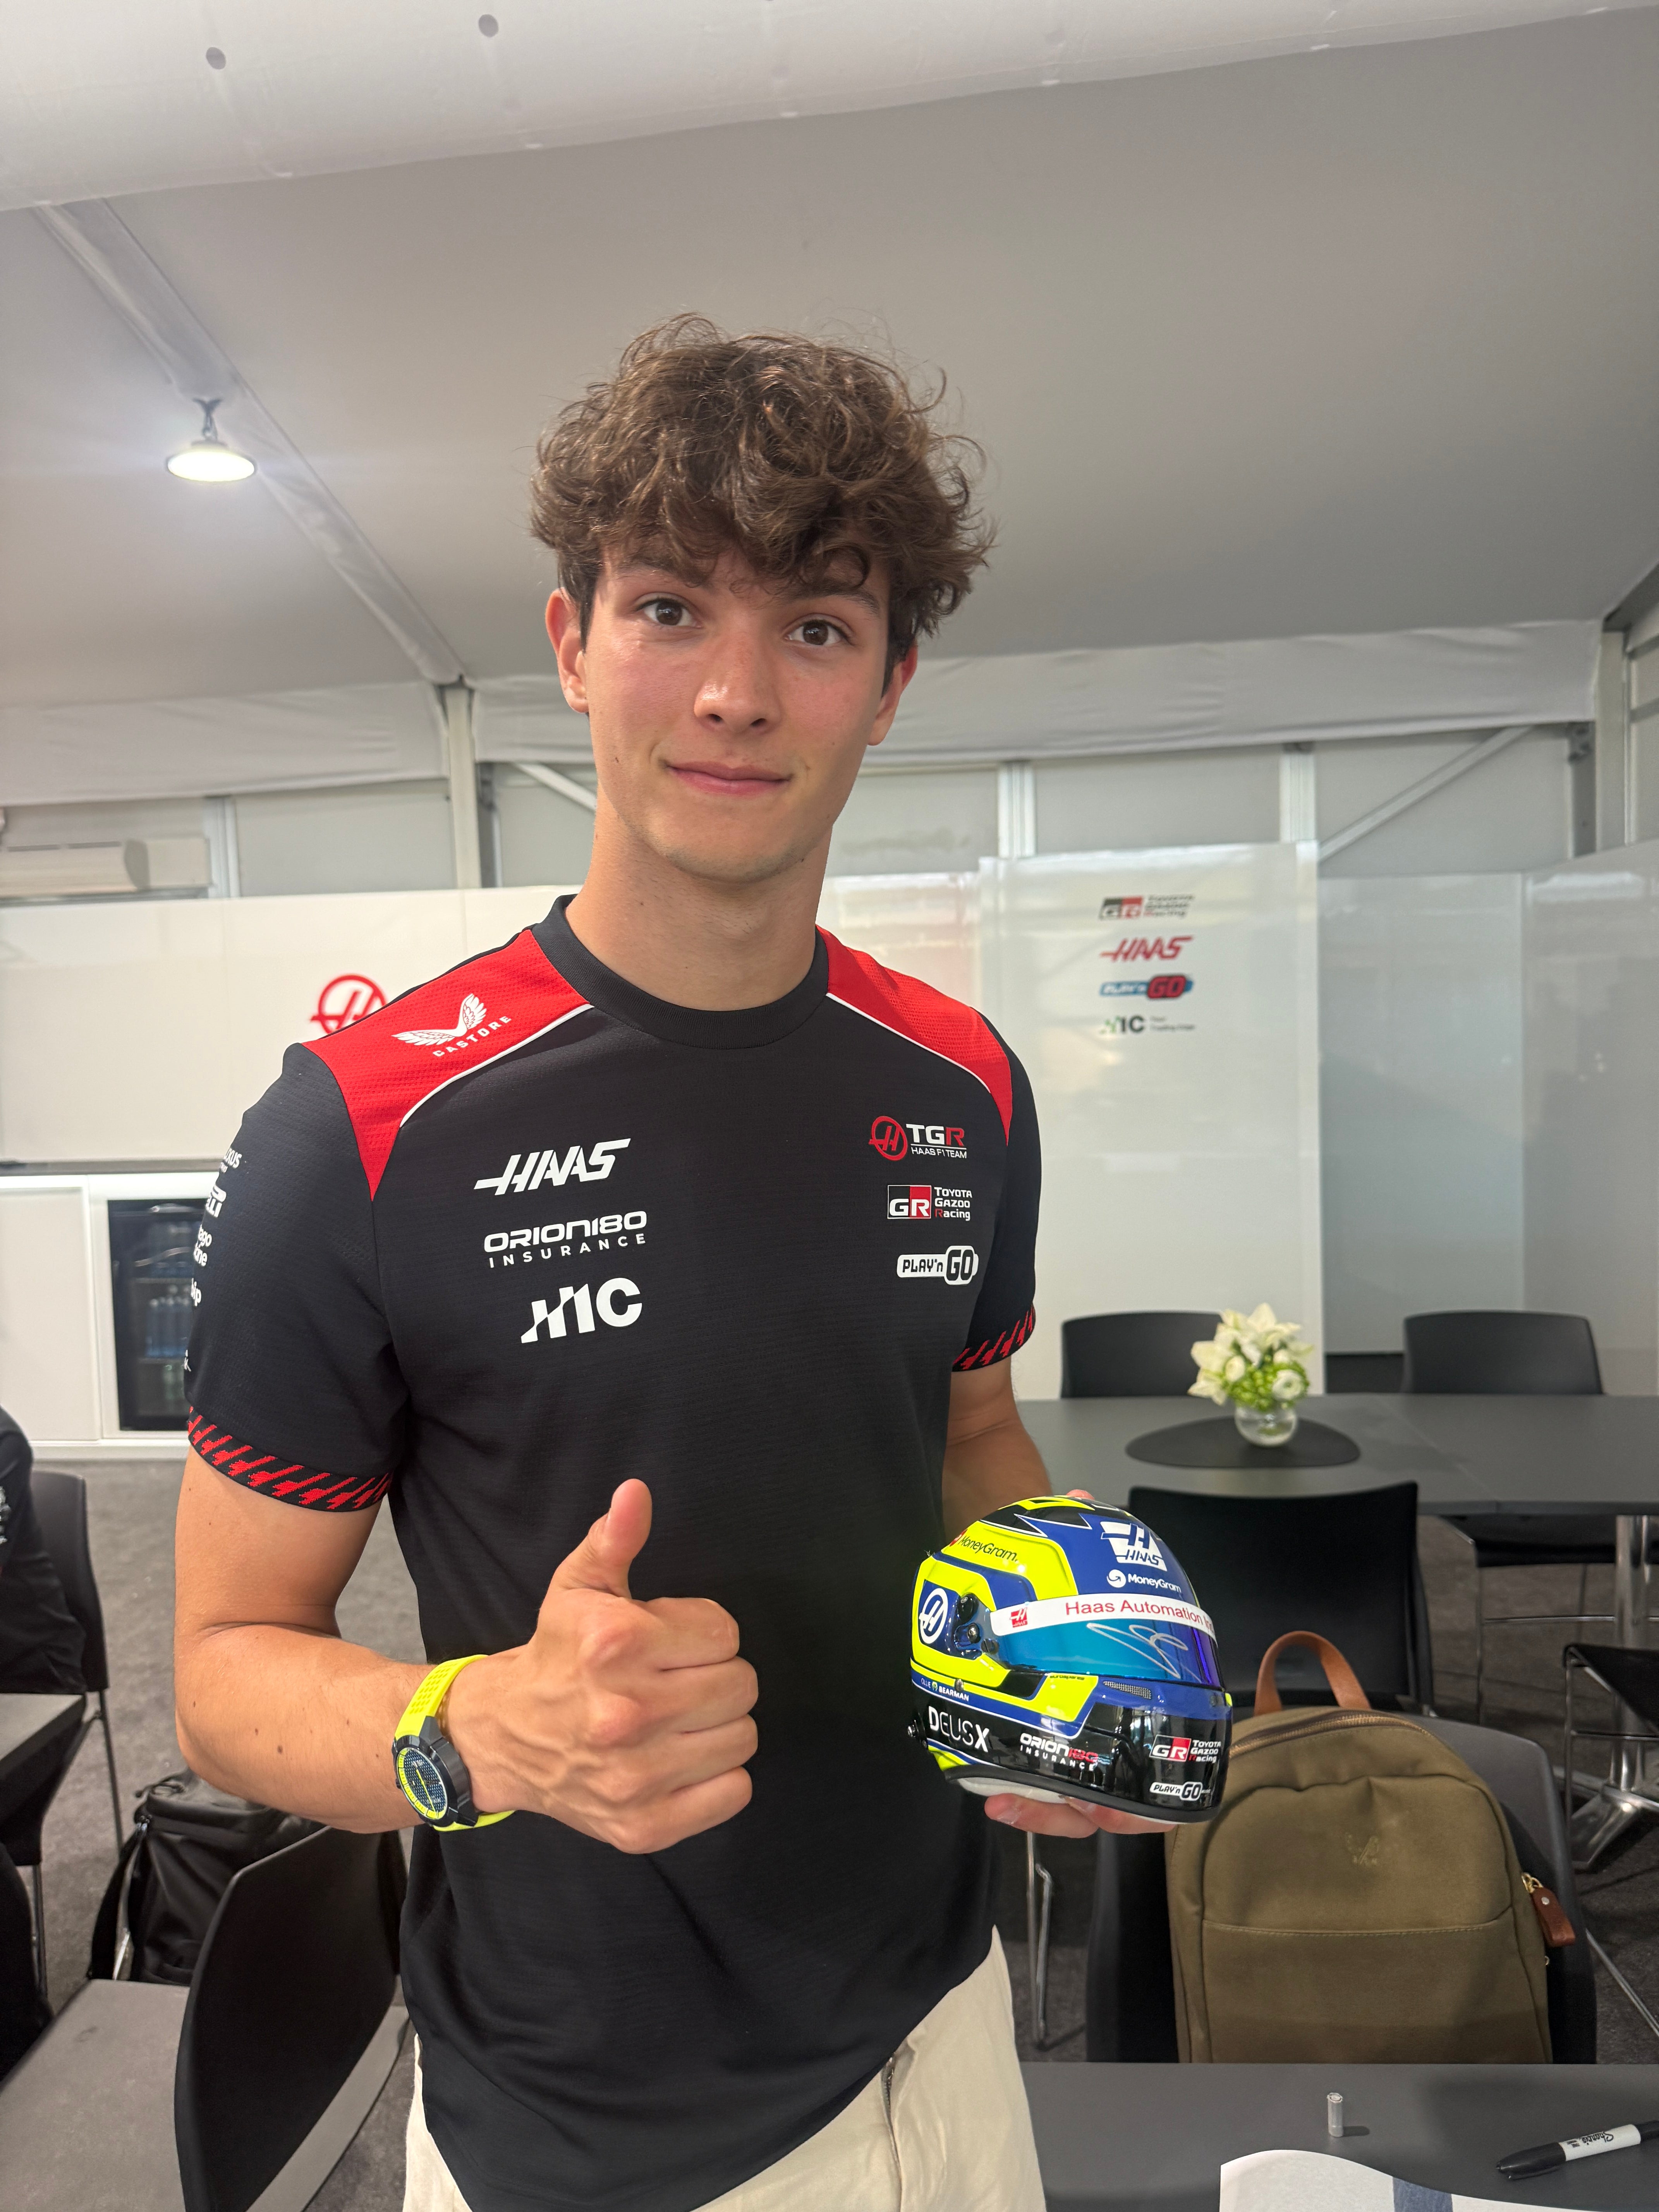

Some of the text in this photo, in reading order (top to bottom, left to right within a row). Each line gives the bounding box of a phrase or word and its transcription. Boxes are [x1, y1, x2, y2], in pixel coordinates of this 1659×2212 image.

[1101, 935, 1193, 962] HAAS
[1147, 975, 1186, 999] GO
[433, 1016, 512, 1057] CASTORE
[906, 1124, 965, 1146] TGR
[911, 1147, 967, 1159] HAAS F1 TEAM
[474, 1138, 631, 1195] HAAS
[934, 1187, 972, 1198] TOYOTA
[890, 1198, 930, 1217] GR
[934, 1198, 970, 1208] GAZOO
[935, 1209, 970, 1221] Racing
[489, 1233, 646, 1269] INSURANCE
[946, 1249, 974, 1281] GO
[1116, 1549, 1163, 1566] HAAS
[1128, 1573, 1182, 1593] MoneyGram
[1066, 1601, 1115, 1615] Haas
[1120, 1600, 1203, 1625] Automation
[939, 1686, 969, 1702] BEARMAN
[1152, 1744, 1188, 1760] GR
[1192, 1740, 1221, 1748] TOYOTA
[1020, 1745, 1097, 1772] INSURANCE
[1188, 1754, 1217, 1764] Racing
[1181, 1783, 1202, 1799] GO
